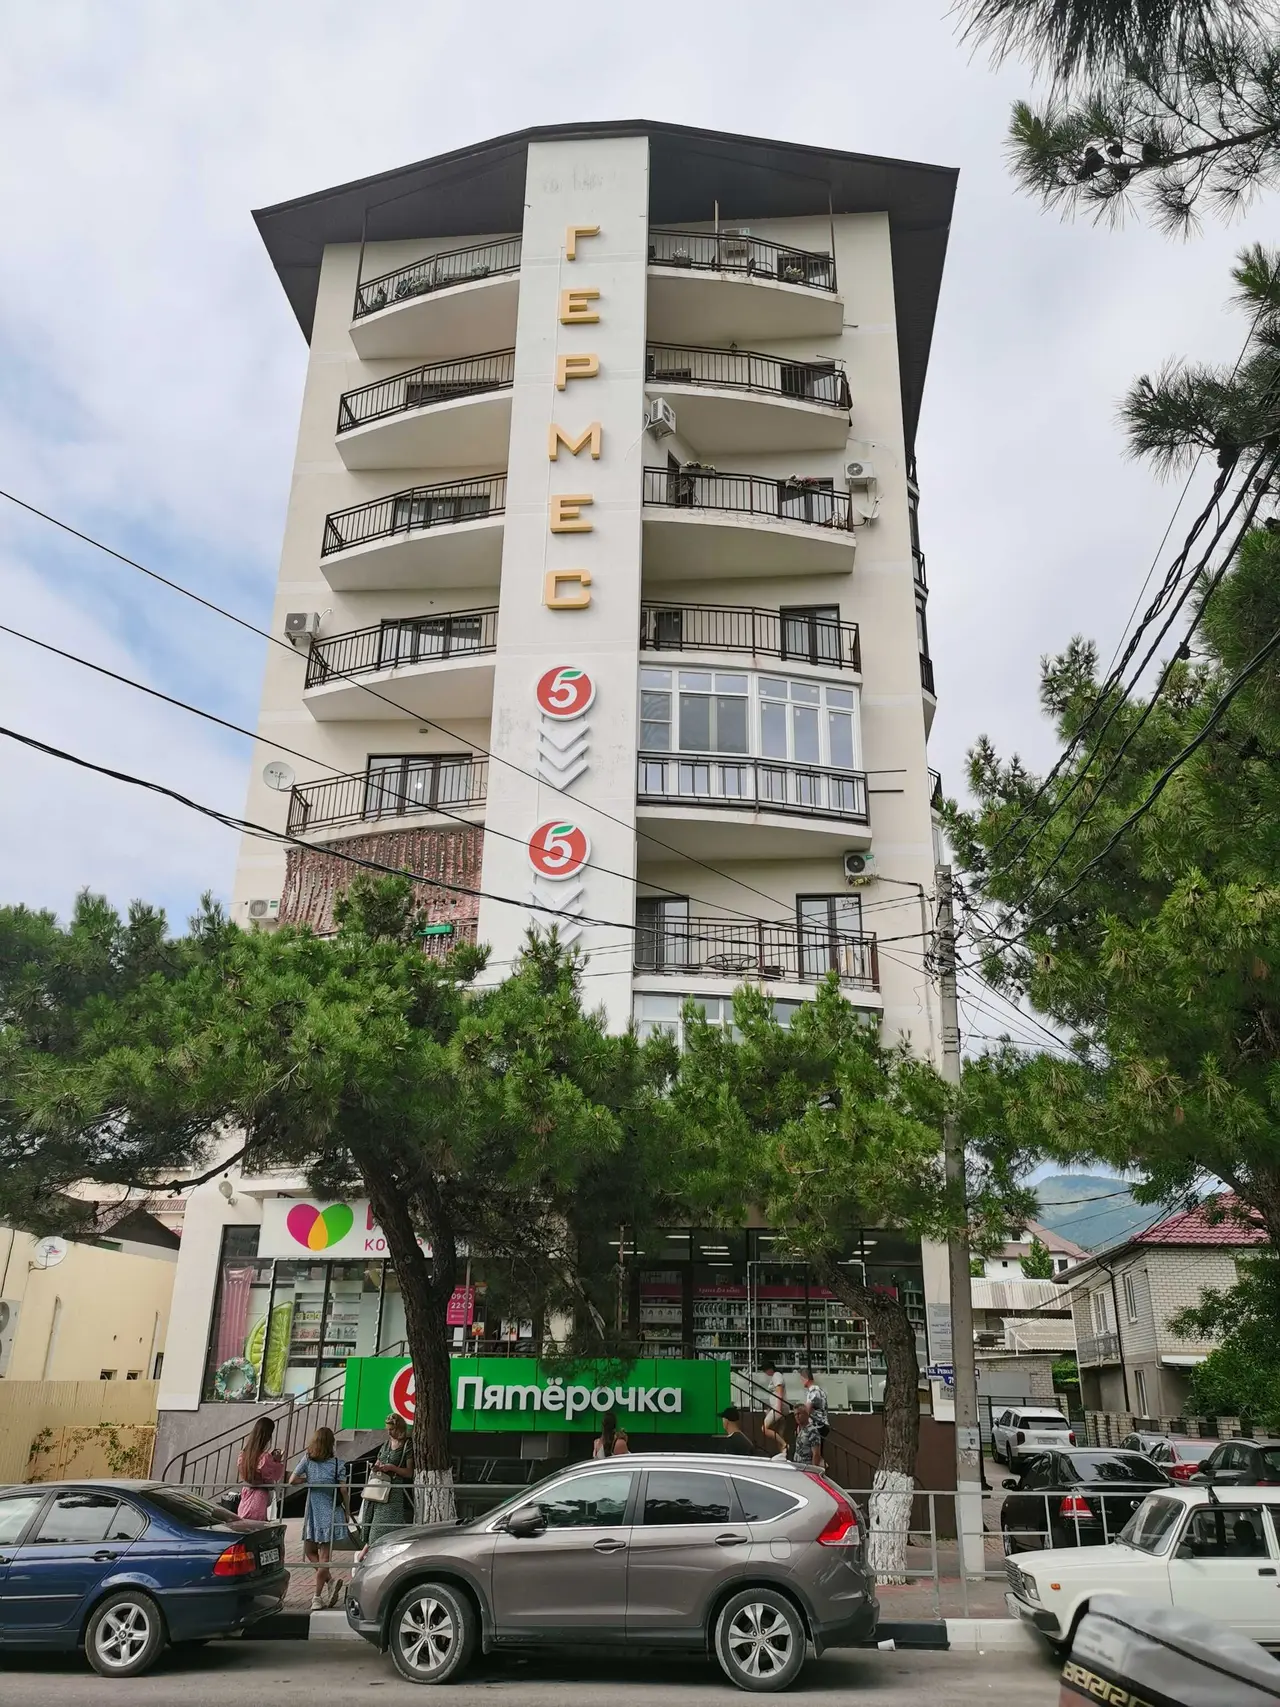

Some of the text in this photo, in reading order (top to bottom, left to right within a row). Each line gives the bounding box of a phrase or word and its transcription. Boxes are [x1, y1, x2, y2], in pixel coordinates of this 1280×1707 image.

[546, 225, 602, 610] ГЕРМЕС
[548, 669, 583, 709] 5
[542, 824, 576, 868] 5
[456, 1376, 682, 1421] Пятёрочка
